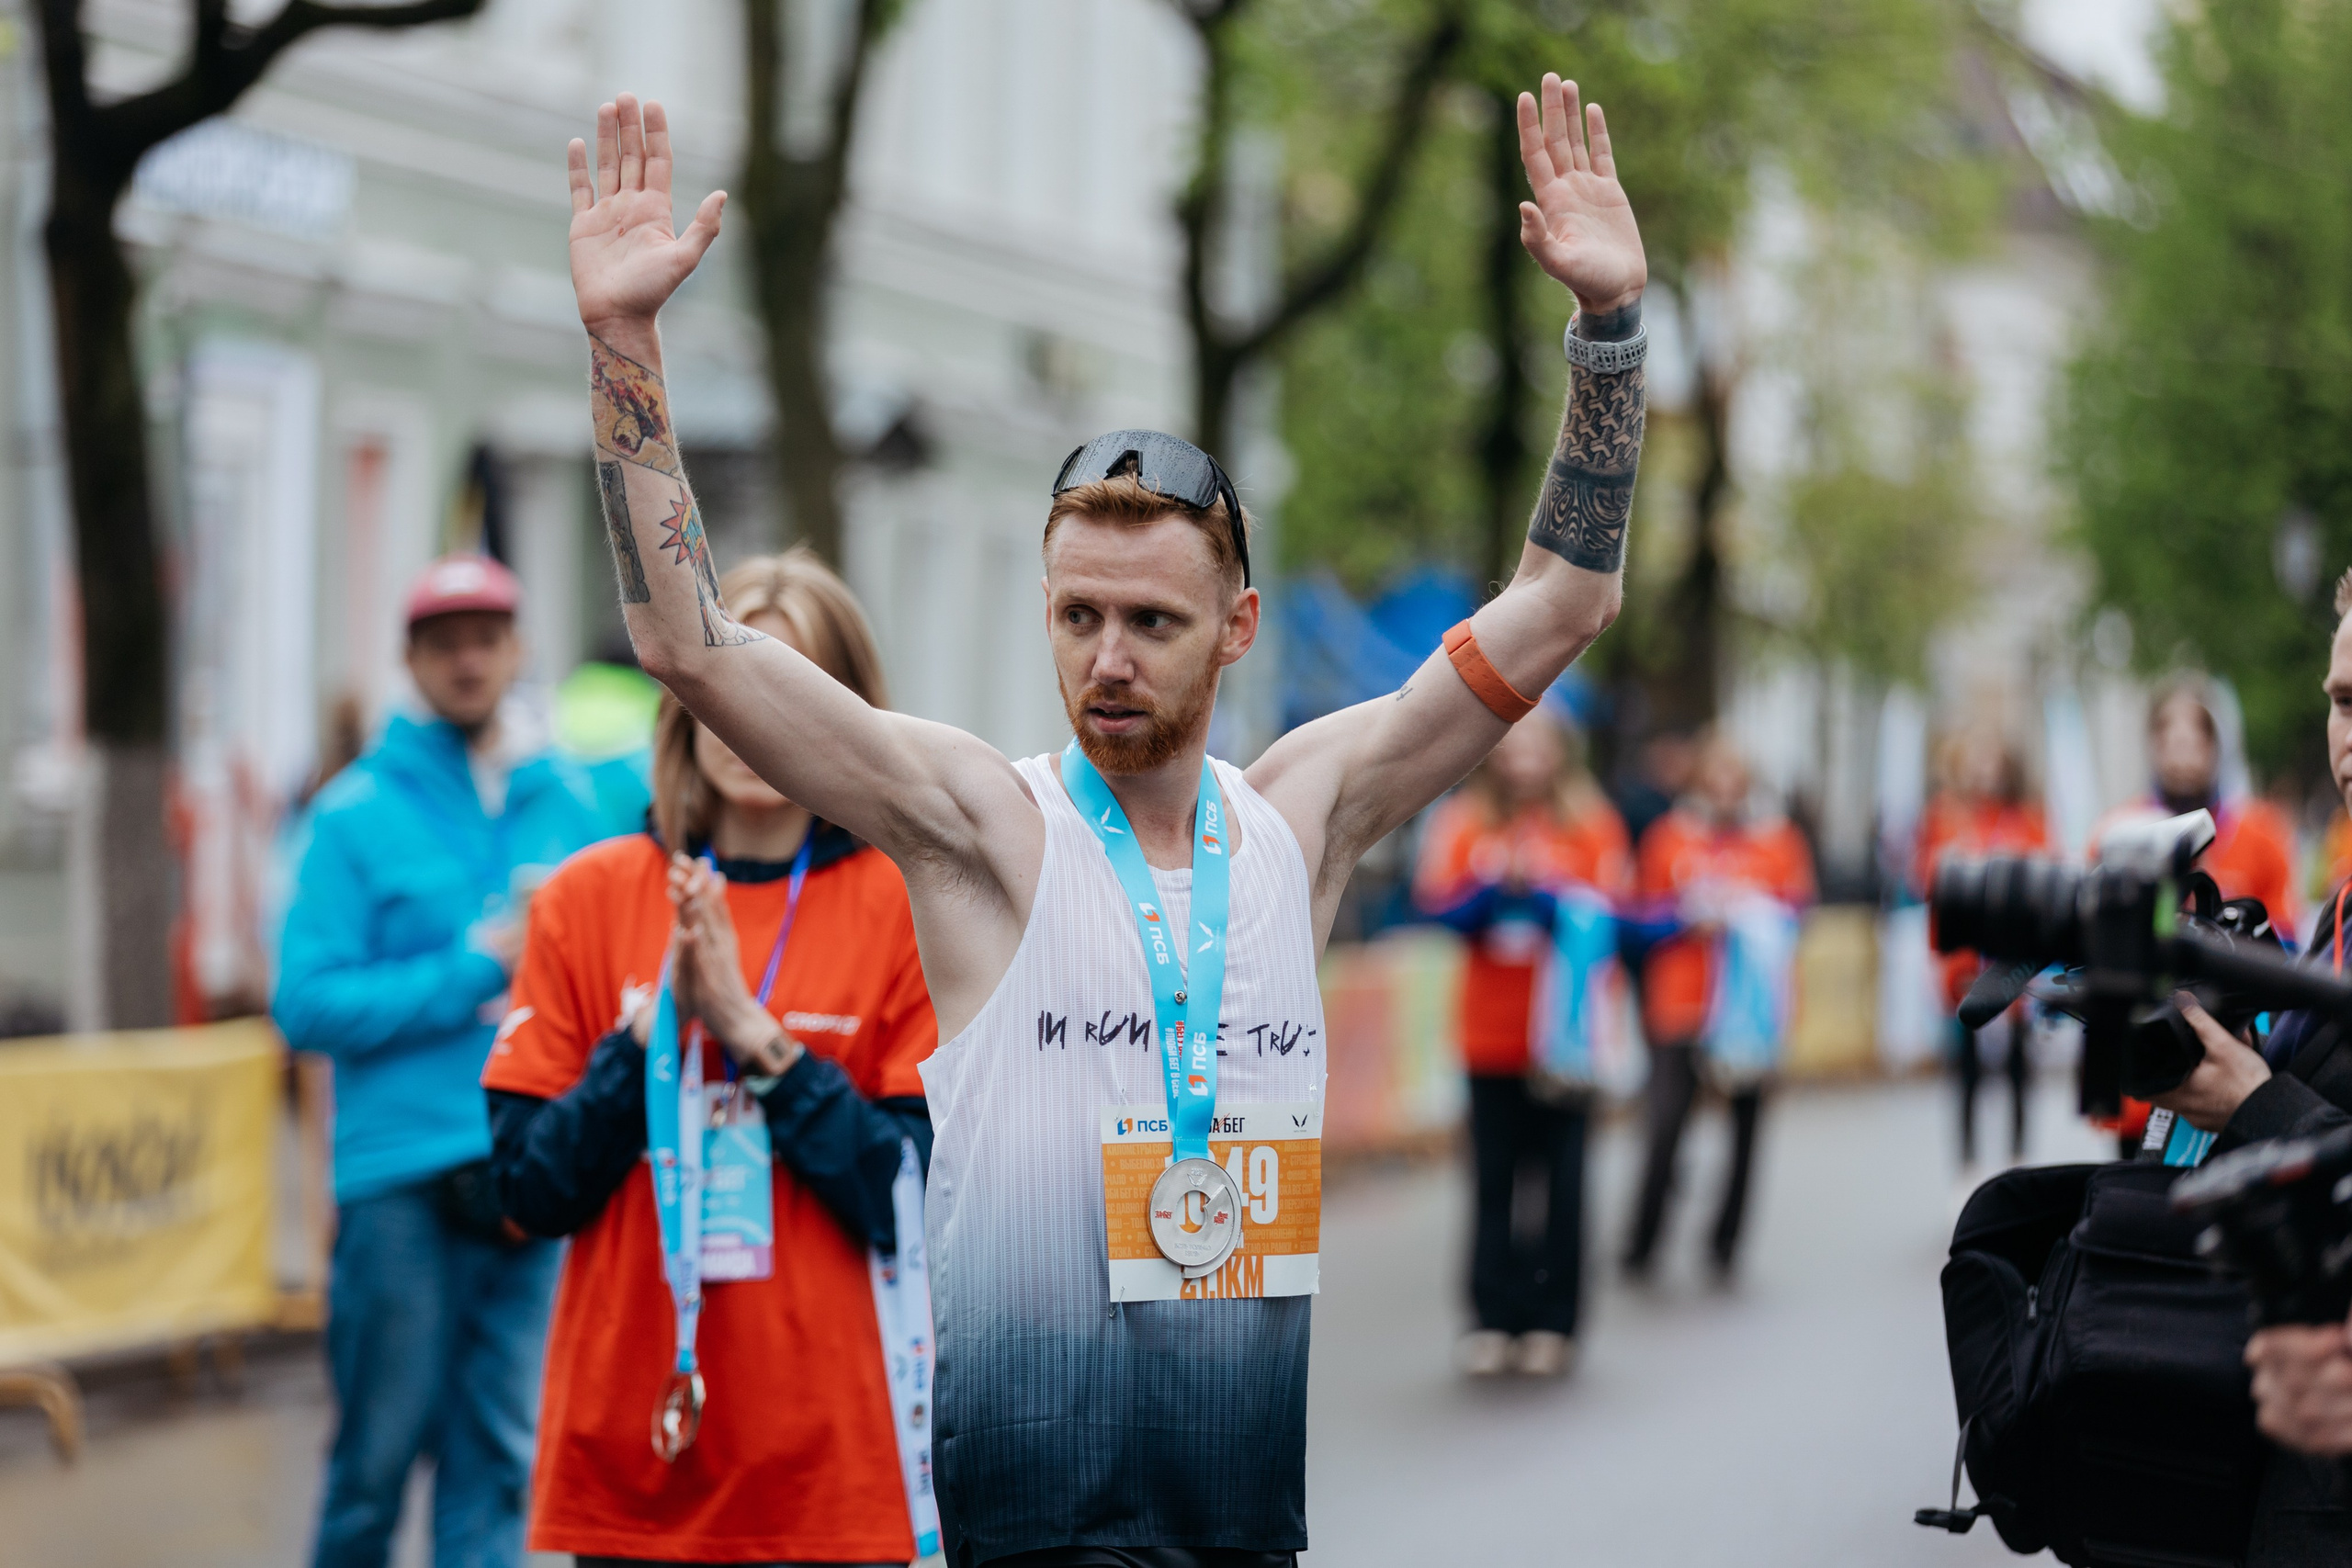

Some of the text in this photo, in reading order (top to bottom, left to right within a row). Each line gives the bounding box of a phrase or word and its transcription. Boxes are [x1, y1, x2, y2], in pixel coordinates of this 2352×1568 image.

[1204, 799, 1218, 835] ПСБ
[1148, 927, 1170, 965] ПСБ
[1192, 1032, 1207, 1070] ПСБ
[1169, 1057, 1181, 1072] БЕГ
[1137, 1120, 1169, 1133] ПСБ
[1107, 1144, 1151, 1156] КИЛОМЕТРЫ
[1120, 1158, 1155, 1169] ВЫБЕГАЮ
[1116, 1202, 1139, 1215] ДАВНО
